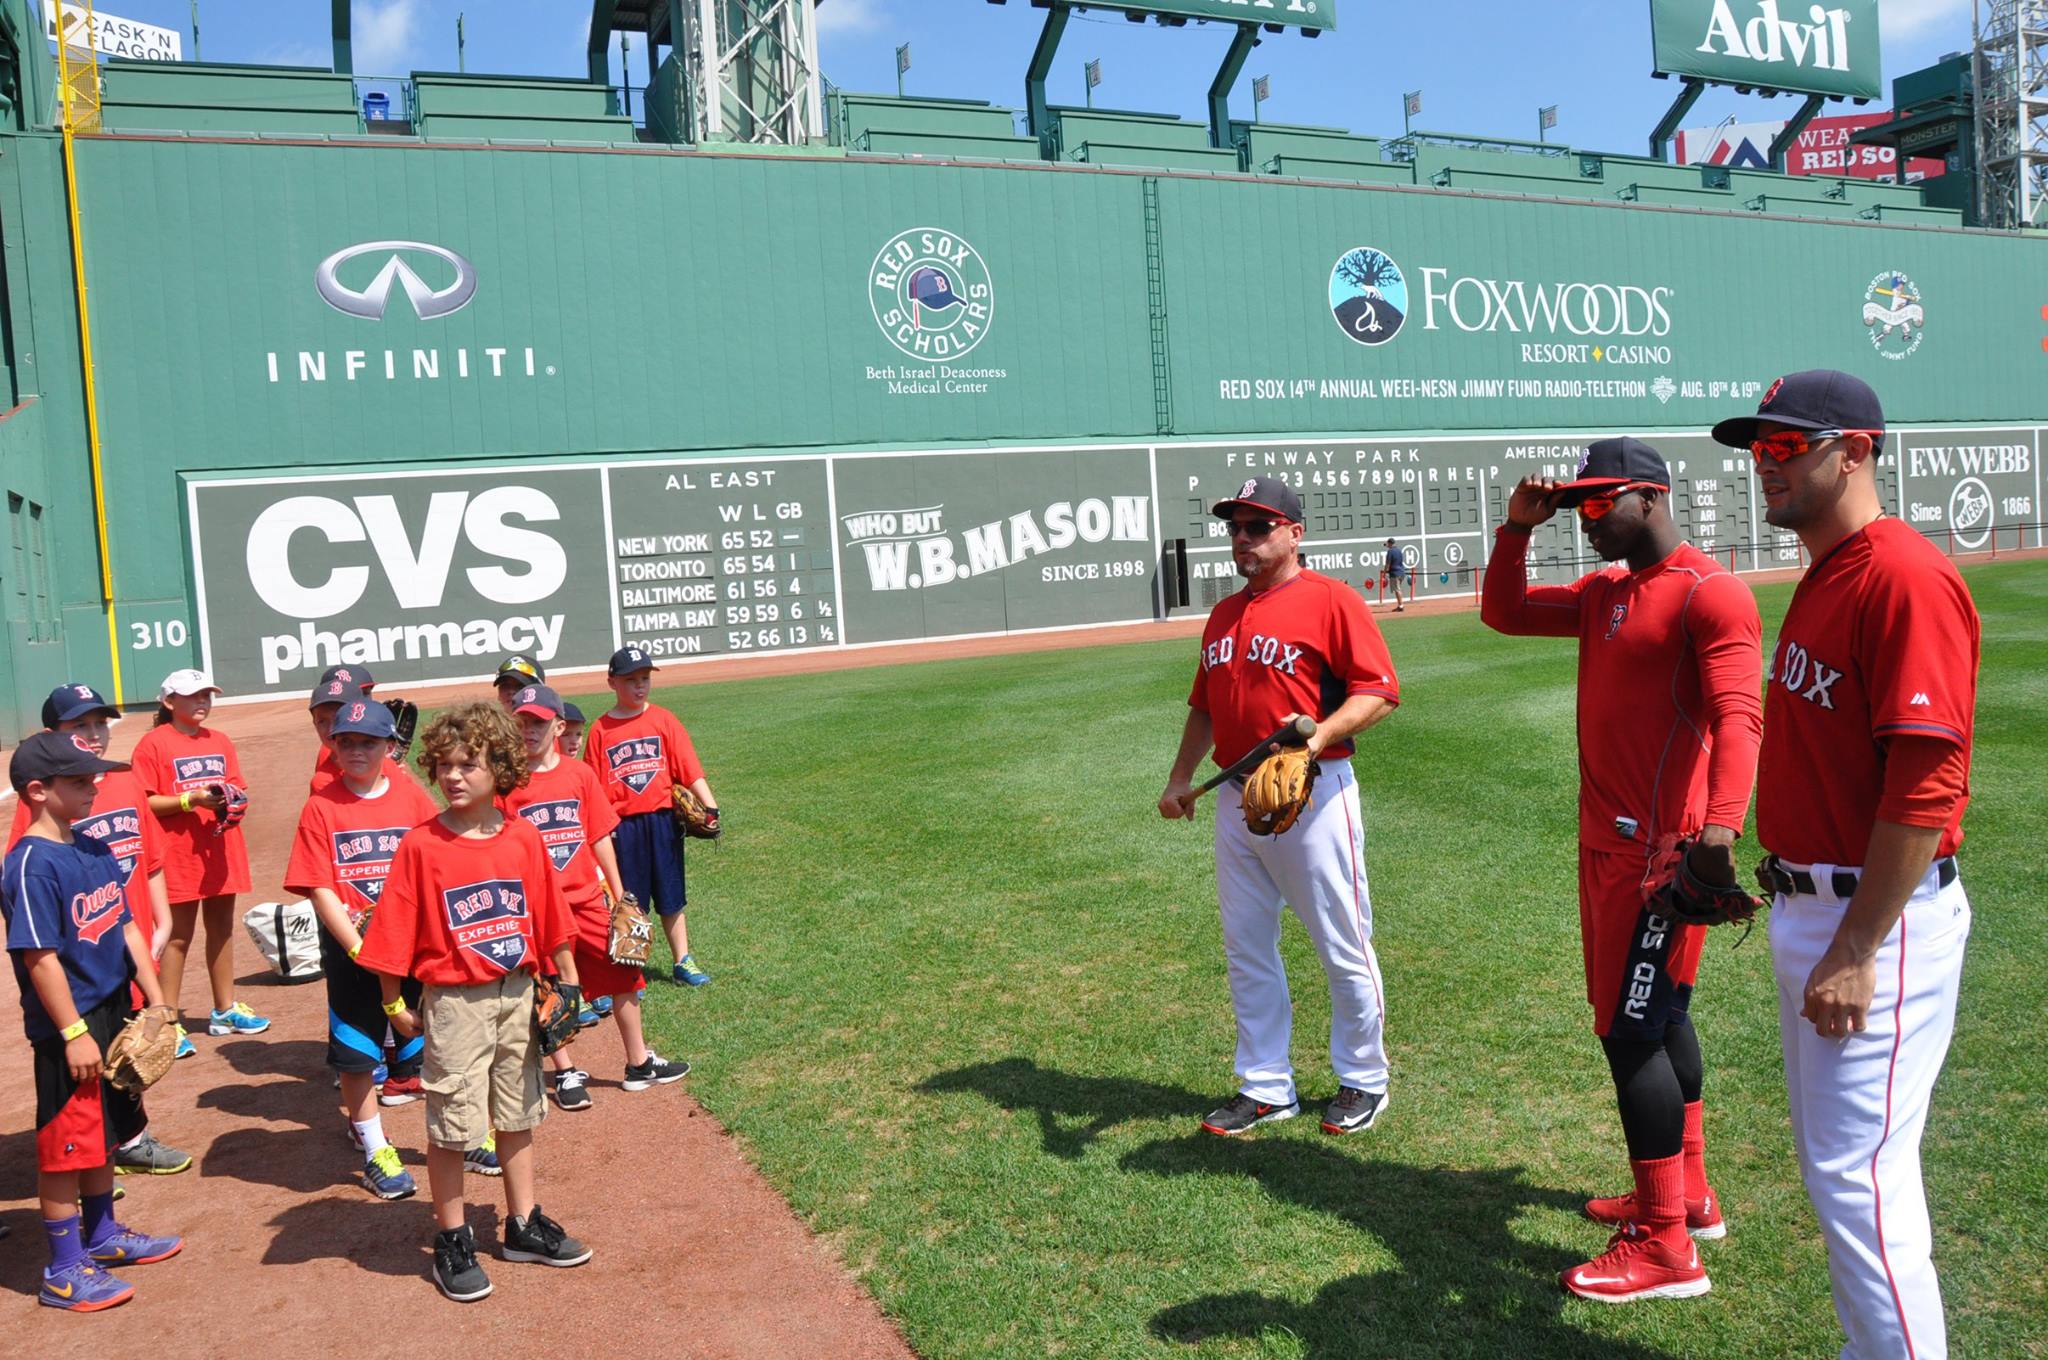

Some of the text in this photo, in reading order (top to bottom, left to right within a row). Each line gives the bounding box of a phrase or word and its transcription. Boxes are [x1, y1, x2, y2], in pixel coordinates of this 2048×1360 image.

[87, 15, 146, 43] CASK
[1696, 0, 1850, 71] Advil
[1798, 127, 1866, 148] WEA
[1901, 122, 1957, 145] MONSTER
[1802, 147, 1896, 170] RED SO
[875, 233, 971, 290] RED SOX
[1864, 271, 1890, 300] BOSTON
[883, 283, 988, 354] SCHOLARS
[267, 347, 534, 382] INFINITI
[1521, 343, 1671, 364] RESORT CASINO
[865, 365, 1007, 379] Beth Israel Deaconess
[888, 380, 988, 394] Medical Center
[1220, 379, 1250, 399] RED
[1255, 379, 1285, 399] SOX
[1290, 379, 1315, 398] 14TH
[1320, 379, 1377, 398] ANNUAL
[1381, 379, 1457, 398] WEEI-NESN
[1461, 380, 1504, 398] JIMMY
[1508, 380, 1542, 398] FUND
[1546, 379, 1646, 398] RADIO-TELETHON
[1681, 380, 1706, 398] AUG.
[1730, 382, 1740, 397] &
[1227, 448, 1421, 467] FENWAY PARK
[1504, 446, 1581, 460] AMERICAN
[1887, 454, 1895, 466] R
[665, 470, 776, 490] AL EAST
[1189, 475, 1199, 491] P
[1294, 471, 1304, 487] 3
[1312, 470, 1322, 486] 4
[1327, 470, 1336, 485] 5
[1340, 470, 1350, 486] 6
[1359, 470, 1367, 485] 7
[1372, 469, 1382, 484] 8
[1385, 469, 1395, 484] 9
[1401, 468, 1415, 483] 10
[1429, 468, 1438, 482] R
[1447, 467, 1458, 481] H
[1466, 466, 1475, 480] E
[1490, 465, 1498, 479] P
[1559, 463, 1568, 477] R
[1678, 461, 1687, 473] P
[1738, 459, 1746, 472] R
[1239, 478, 1258, 498] B
[1695, 479, 1717, 491] WSH
[1697, 494, 1717, 506] COL
[1911, 496, 2031, 522] Since 1866
[719, 502, 803, 522] W L GB
[1700, 509, 1716, 522] ARI
[845, 509, 942, 539] WHO BUT
[1700, 524, 1716, 536] PIT
[246, 485, 567, 618] CVS
[618, 530, 774, 556] NEW YORK 65 52
[620, 560, 706, 580] TORONTO
[723, 556, 746, 575] 65
[752, 554, 775, 573] 54
[1041, 560, 1145, 582] SINCE 1898
[1193, 551, 1387, 579] AT BAT STRIKE OUT
[622, 577, 801, 606] BALTIMORE 61 56 4
[624, 613, 680, 633] TAMPA
[685, 609, 716, 628] BAY
[726, 606, 750, 625] 59
[755, 604, 779, 622] 59
[791, 602, 802, 620] 6
[131, 618, 187, 650] 310
[728, 631, 752, 650] 52
[757, 630, 781, 647] 66
[789, 626, 808, 644] 13
[261, 613, 565, 685] pharmacy
[1247, 634, 1303, 675] SOX
[191, 671, 203, 683] B
[1781, 641, 1843, 709] SOX
[79, 685, 94, 700] B
[328, 681, 343, 695] B
[522, 687, 537, 703] B
[347, 701, 366, 722] B
[612, 744, 632, 766] RED
[179, 760, 204, 778] RED
[339, 835, 402, 860] RED SO
[340, 864, 392, 878] EXPERIE
[454, 887, 523, 921] RED OX
[458, 920, 520, 943] EXPERIE
[1624, 913, 1668, 1020] RED SO
